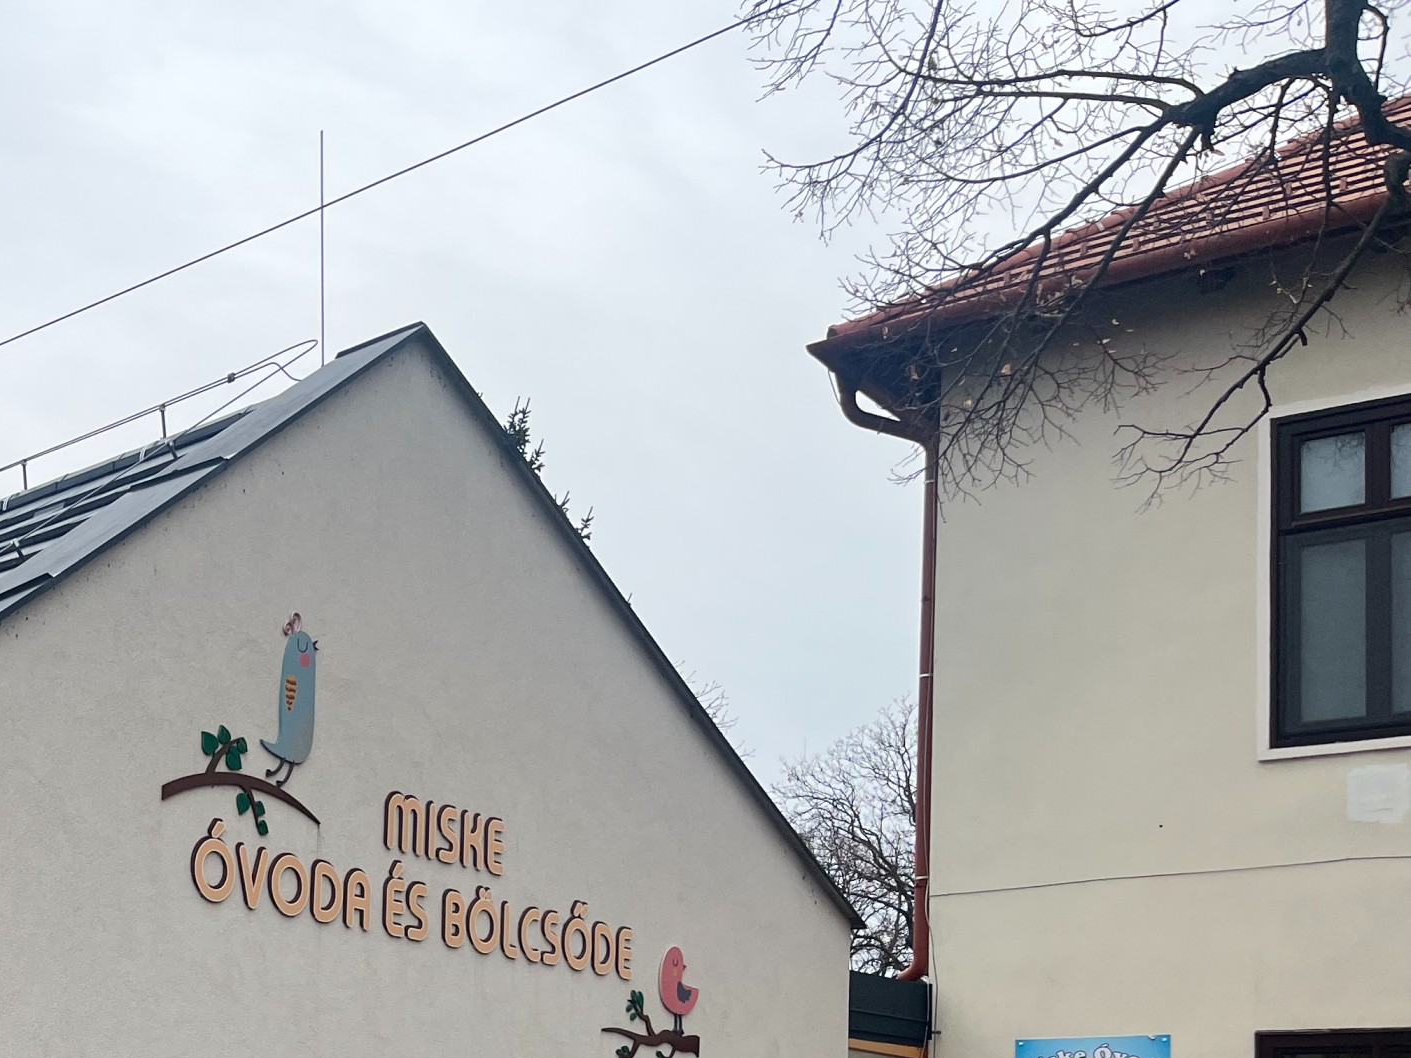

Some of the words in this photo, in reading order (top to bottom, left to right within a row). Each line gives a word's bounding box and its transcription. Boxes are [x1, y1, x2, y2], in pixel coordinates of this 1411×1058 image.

[384, 791, 505, 875] MISKE
[191, 818, 371, 931] ÓVODA
[382, 860, 429, 941] ÉS
[442, 885, 633, 980] BÖLCSŐDE
